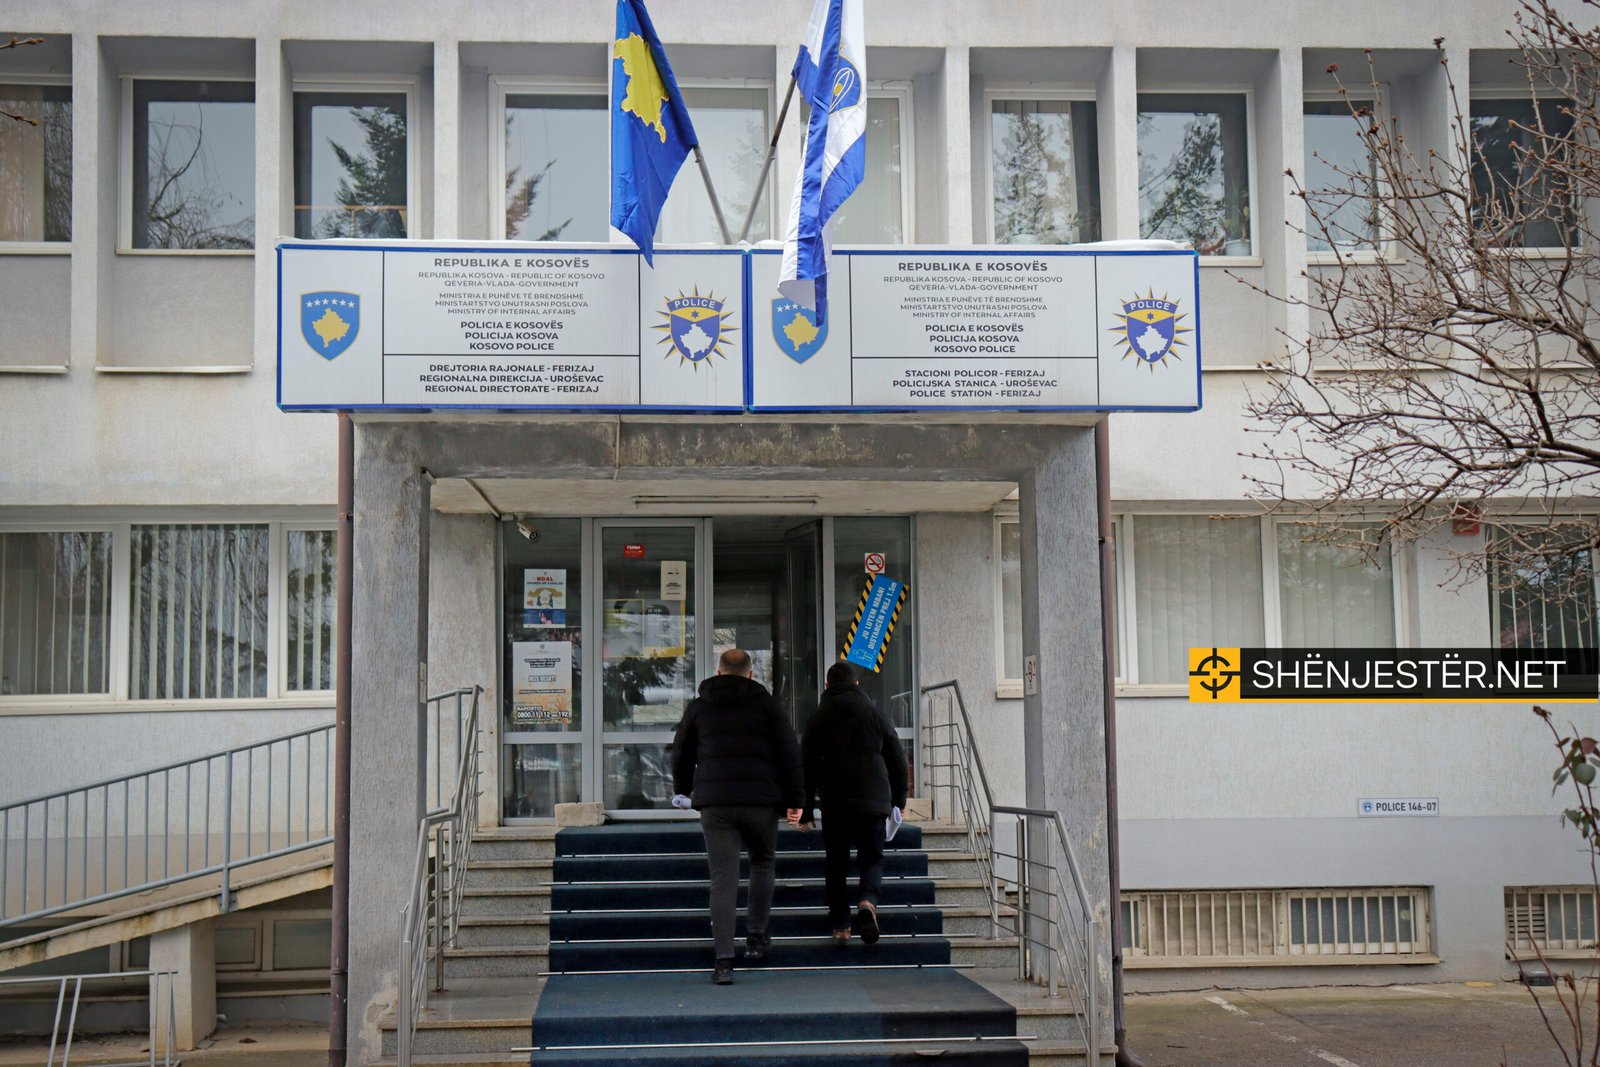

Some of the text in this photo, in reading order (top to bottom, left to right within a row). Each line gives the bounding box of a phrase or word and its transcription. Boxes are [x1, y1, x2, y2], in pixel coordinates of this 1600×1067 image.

[434, 258, 509, 267] REPUBLIKA
[527, 257, 590, 268] KOSOVËS
[899, 262, 970, 271] REPUBLIKA
[988, 261, 1047, 271] KOSOVËS
[674, 299, 716, 308] POLICE
[1130, 301, 1170, 310] POLICE
[514, 320, 563, 329] KOSOVËS
[977, 323, 1024, 332] KOSOVËS
[551, 373, 604, 383] UROŠEVAC
[1006, 378, 1057, 387] UROŠEVAC
[880, 598, 891, 614] PREJ
[862, 587, 885, 639] JU LUTEM MBANI
[1376, 802, 1436, 811] POLICE 146-07
